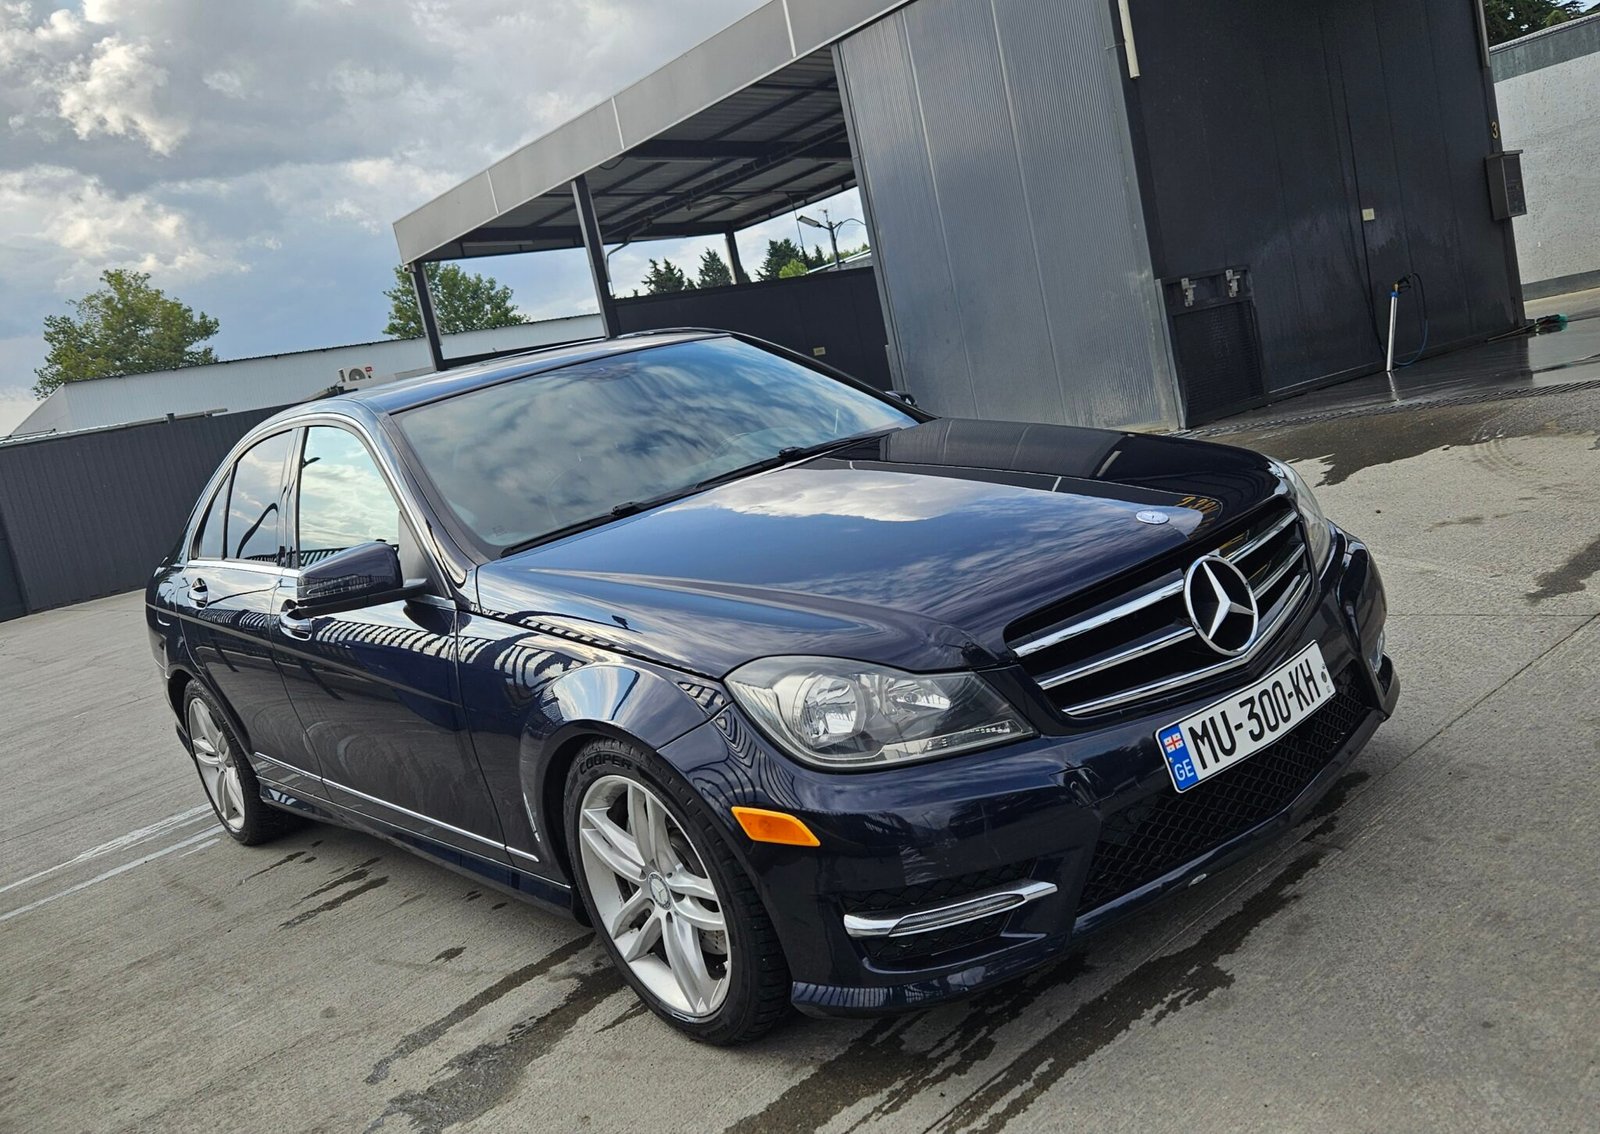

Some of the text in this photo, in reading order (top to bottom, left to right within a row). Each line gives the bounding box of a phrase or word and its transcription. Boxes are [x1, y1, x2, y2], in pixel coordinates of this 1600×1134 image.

[1491, 121, 1499, 139] 3
[1188, 658, 1321, 770] MU-300-KH
[580, 752, 632, 774] COOPER
[1175, 759, 1194, 781] GE
